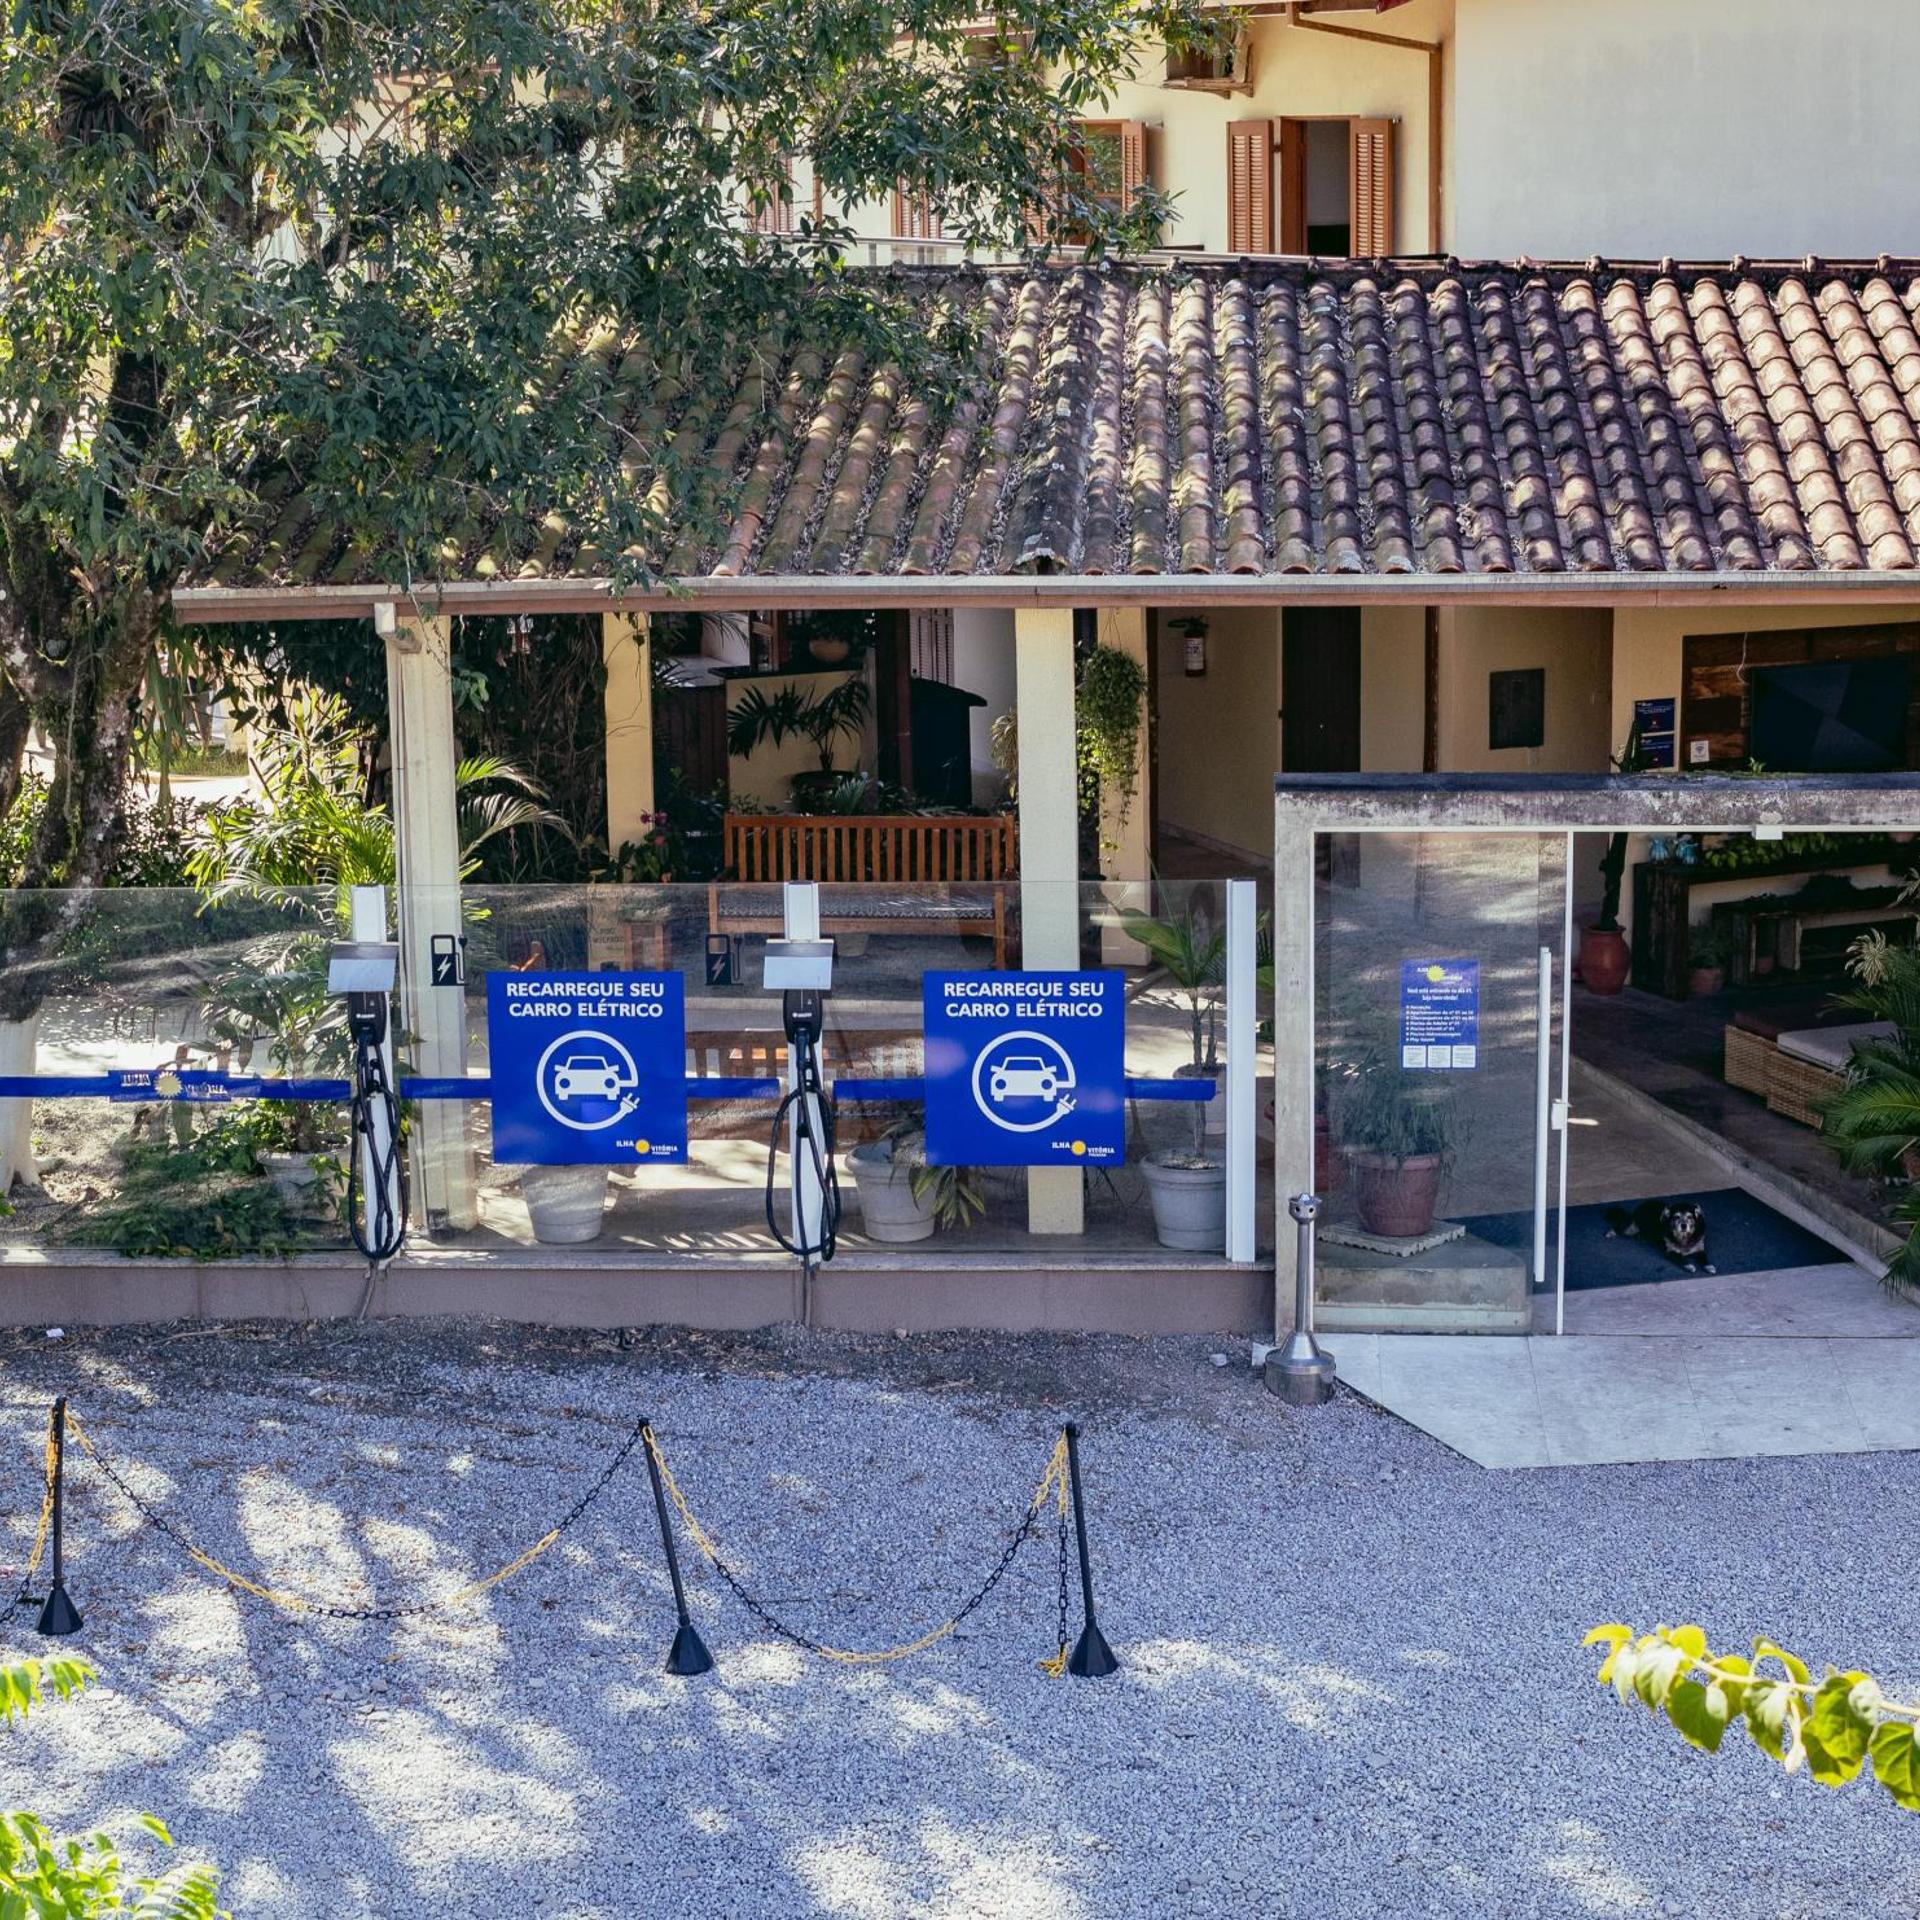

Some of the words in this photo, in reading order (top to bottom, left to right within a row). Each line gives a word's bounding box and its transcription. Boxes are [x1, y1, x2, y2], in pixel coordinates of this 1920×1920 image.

[506, 982, 624, 997] RECARREGUE
[630, 982, 665, 998] SEU
[944, 982, 1063, 997] RECARREGUE
[1068, 982, 1104, 998] SEU
[508, 1002, 572, 1018] CARRO
[577, 999, 664, 1018] ELÉTRICO
[945, 1002, 1010, 1018] CARRO
[1015, 999, 1103, 1018] ELÉTRICO
[616, 1140, 635, 1148] ILHA
[651, 1144, 679, 1152] VITÓRIA
[1051, 1141, 1071, 1149] ILHA
[1087, 1146, 1115, 1154] VITÓRIA
